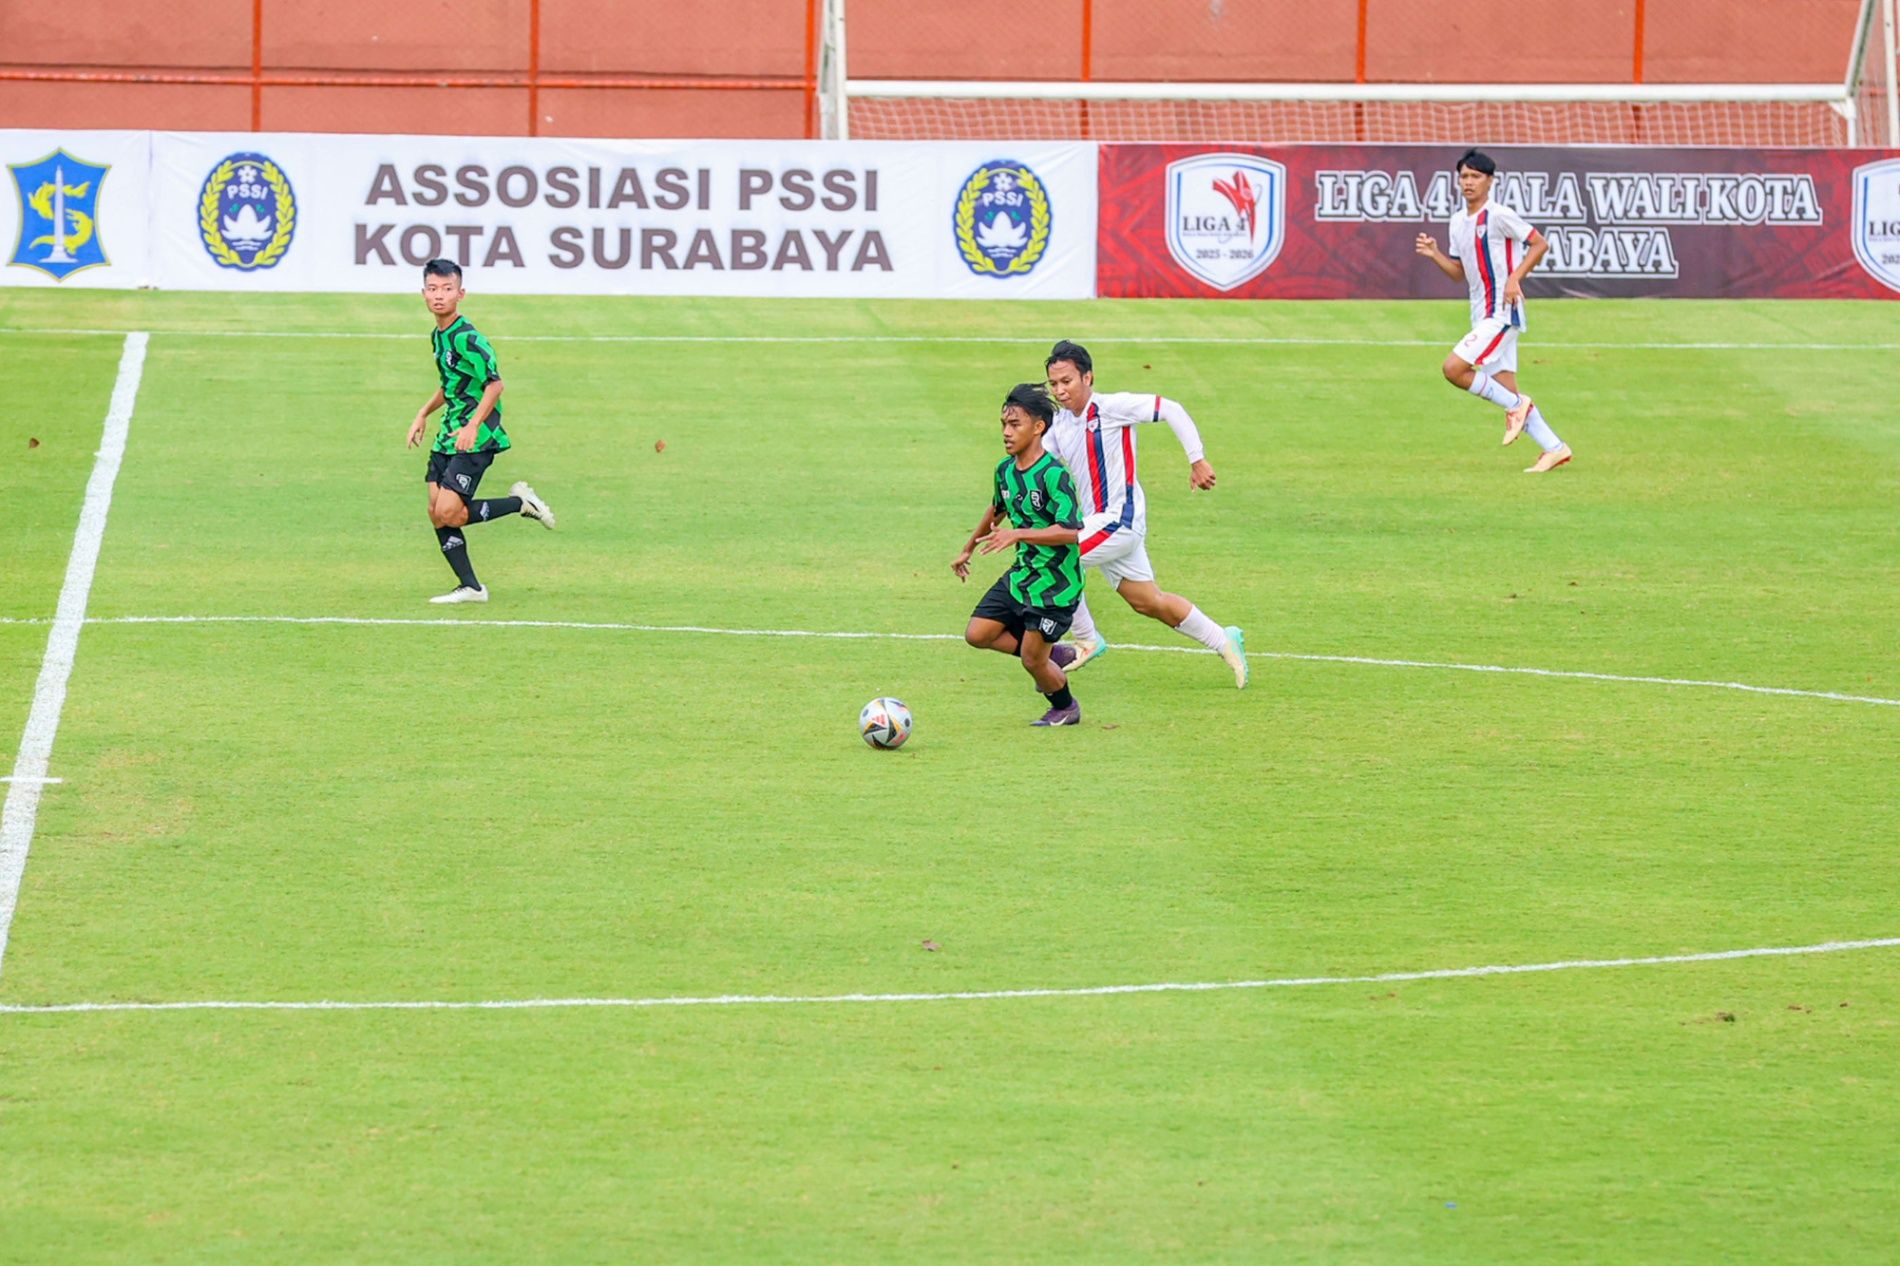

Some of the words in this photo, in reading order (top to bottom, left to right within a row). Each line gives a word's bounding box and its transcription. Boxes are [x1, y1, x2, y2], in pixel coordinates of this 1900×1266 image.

[227, 184, 268, 199] PSSI
[364, 164, 710, 210] ASSOSIASI
[739, 169, 878, 211] PSSI
[982, 191, 1023, 207] PSSI
[1317, 172, 1422, 219] LIGA
[1426, 173, 1453, 220] 4
[1458, 174, 1584, 221] ALA
[1588, 175, 1699, 222] WALI
[1704, 175, 1821, 223] KOTA
[1183, 215, 1230, 231] LIGA
[1869, 221, 1900, 236] LIG
[354, 223, 526, 268] KOTA
[548, 226, 894, 271] SURABAYA
[1522, 228, 1677, 277] ABAYA
[1882, 254, 1900, 264] 202
